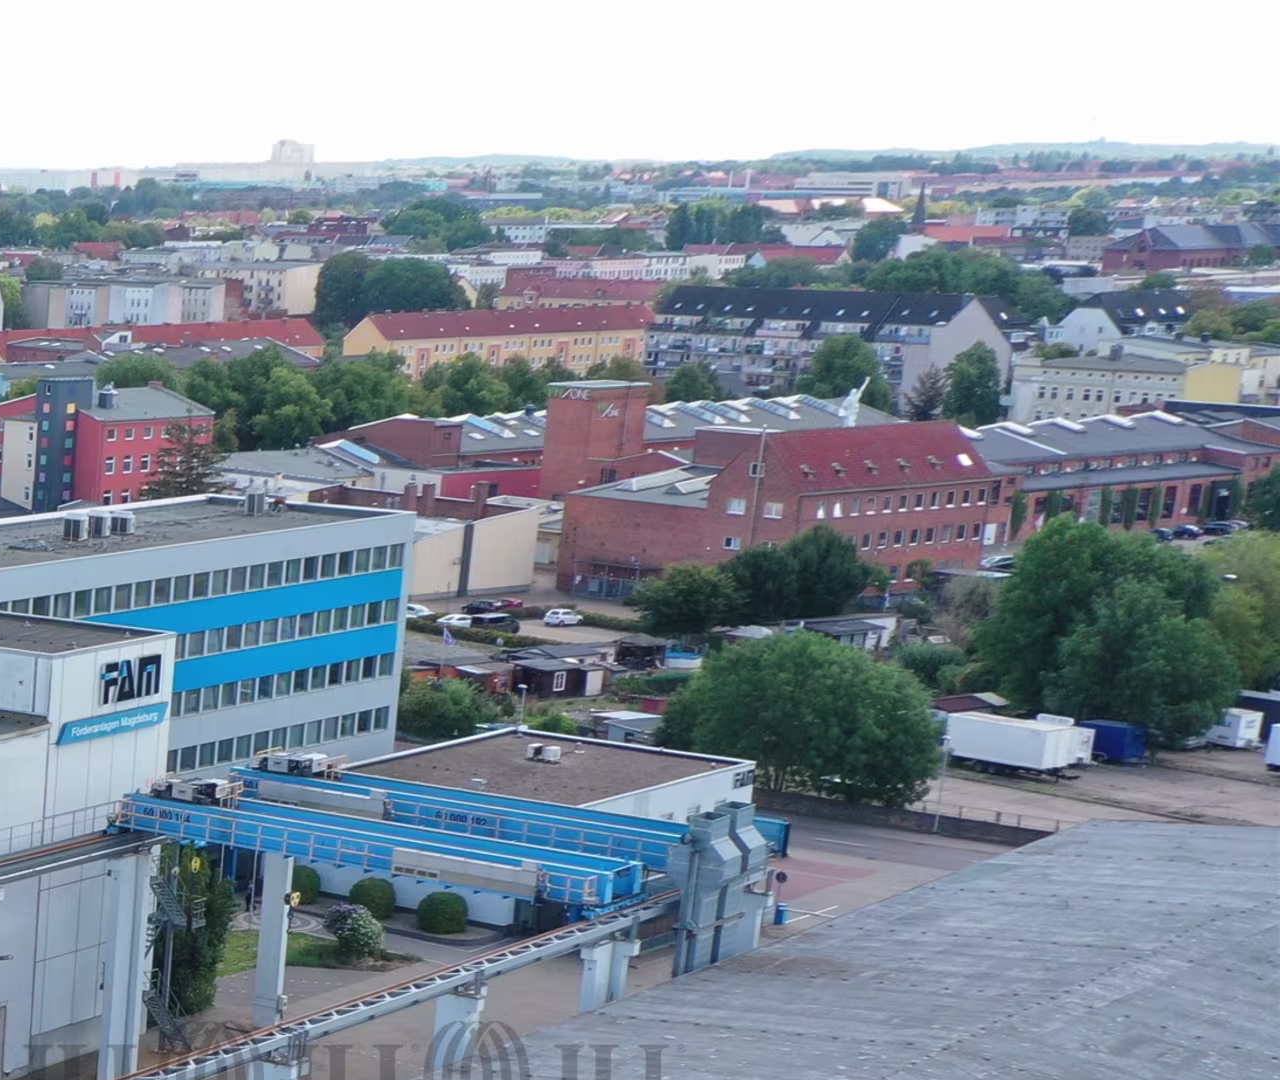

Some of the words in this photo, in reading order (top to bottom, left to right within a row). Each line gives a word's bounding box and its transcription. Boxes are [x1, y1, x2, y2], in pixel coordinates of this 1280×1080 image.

[100, 654, 162, 704] FAM
[71, 720, 120, 737] Förderanlagen
[121, 712, 159, 727] Magdeburg
